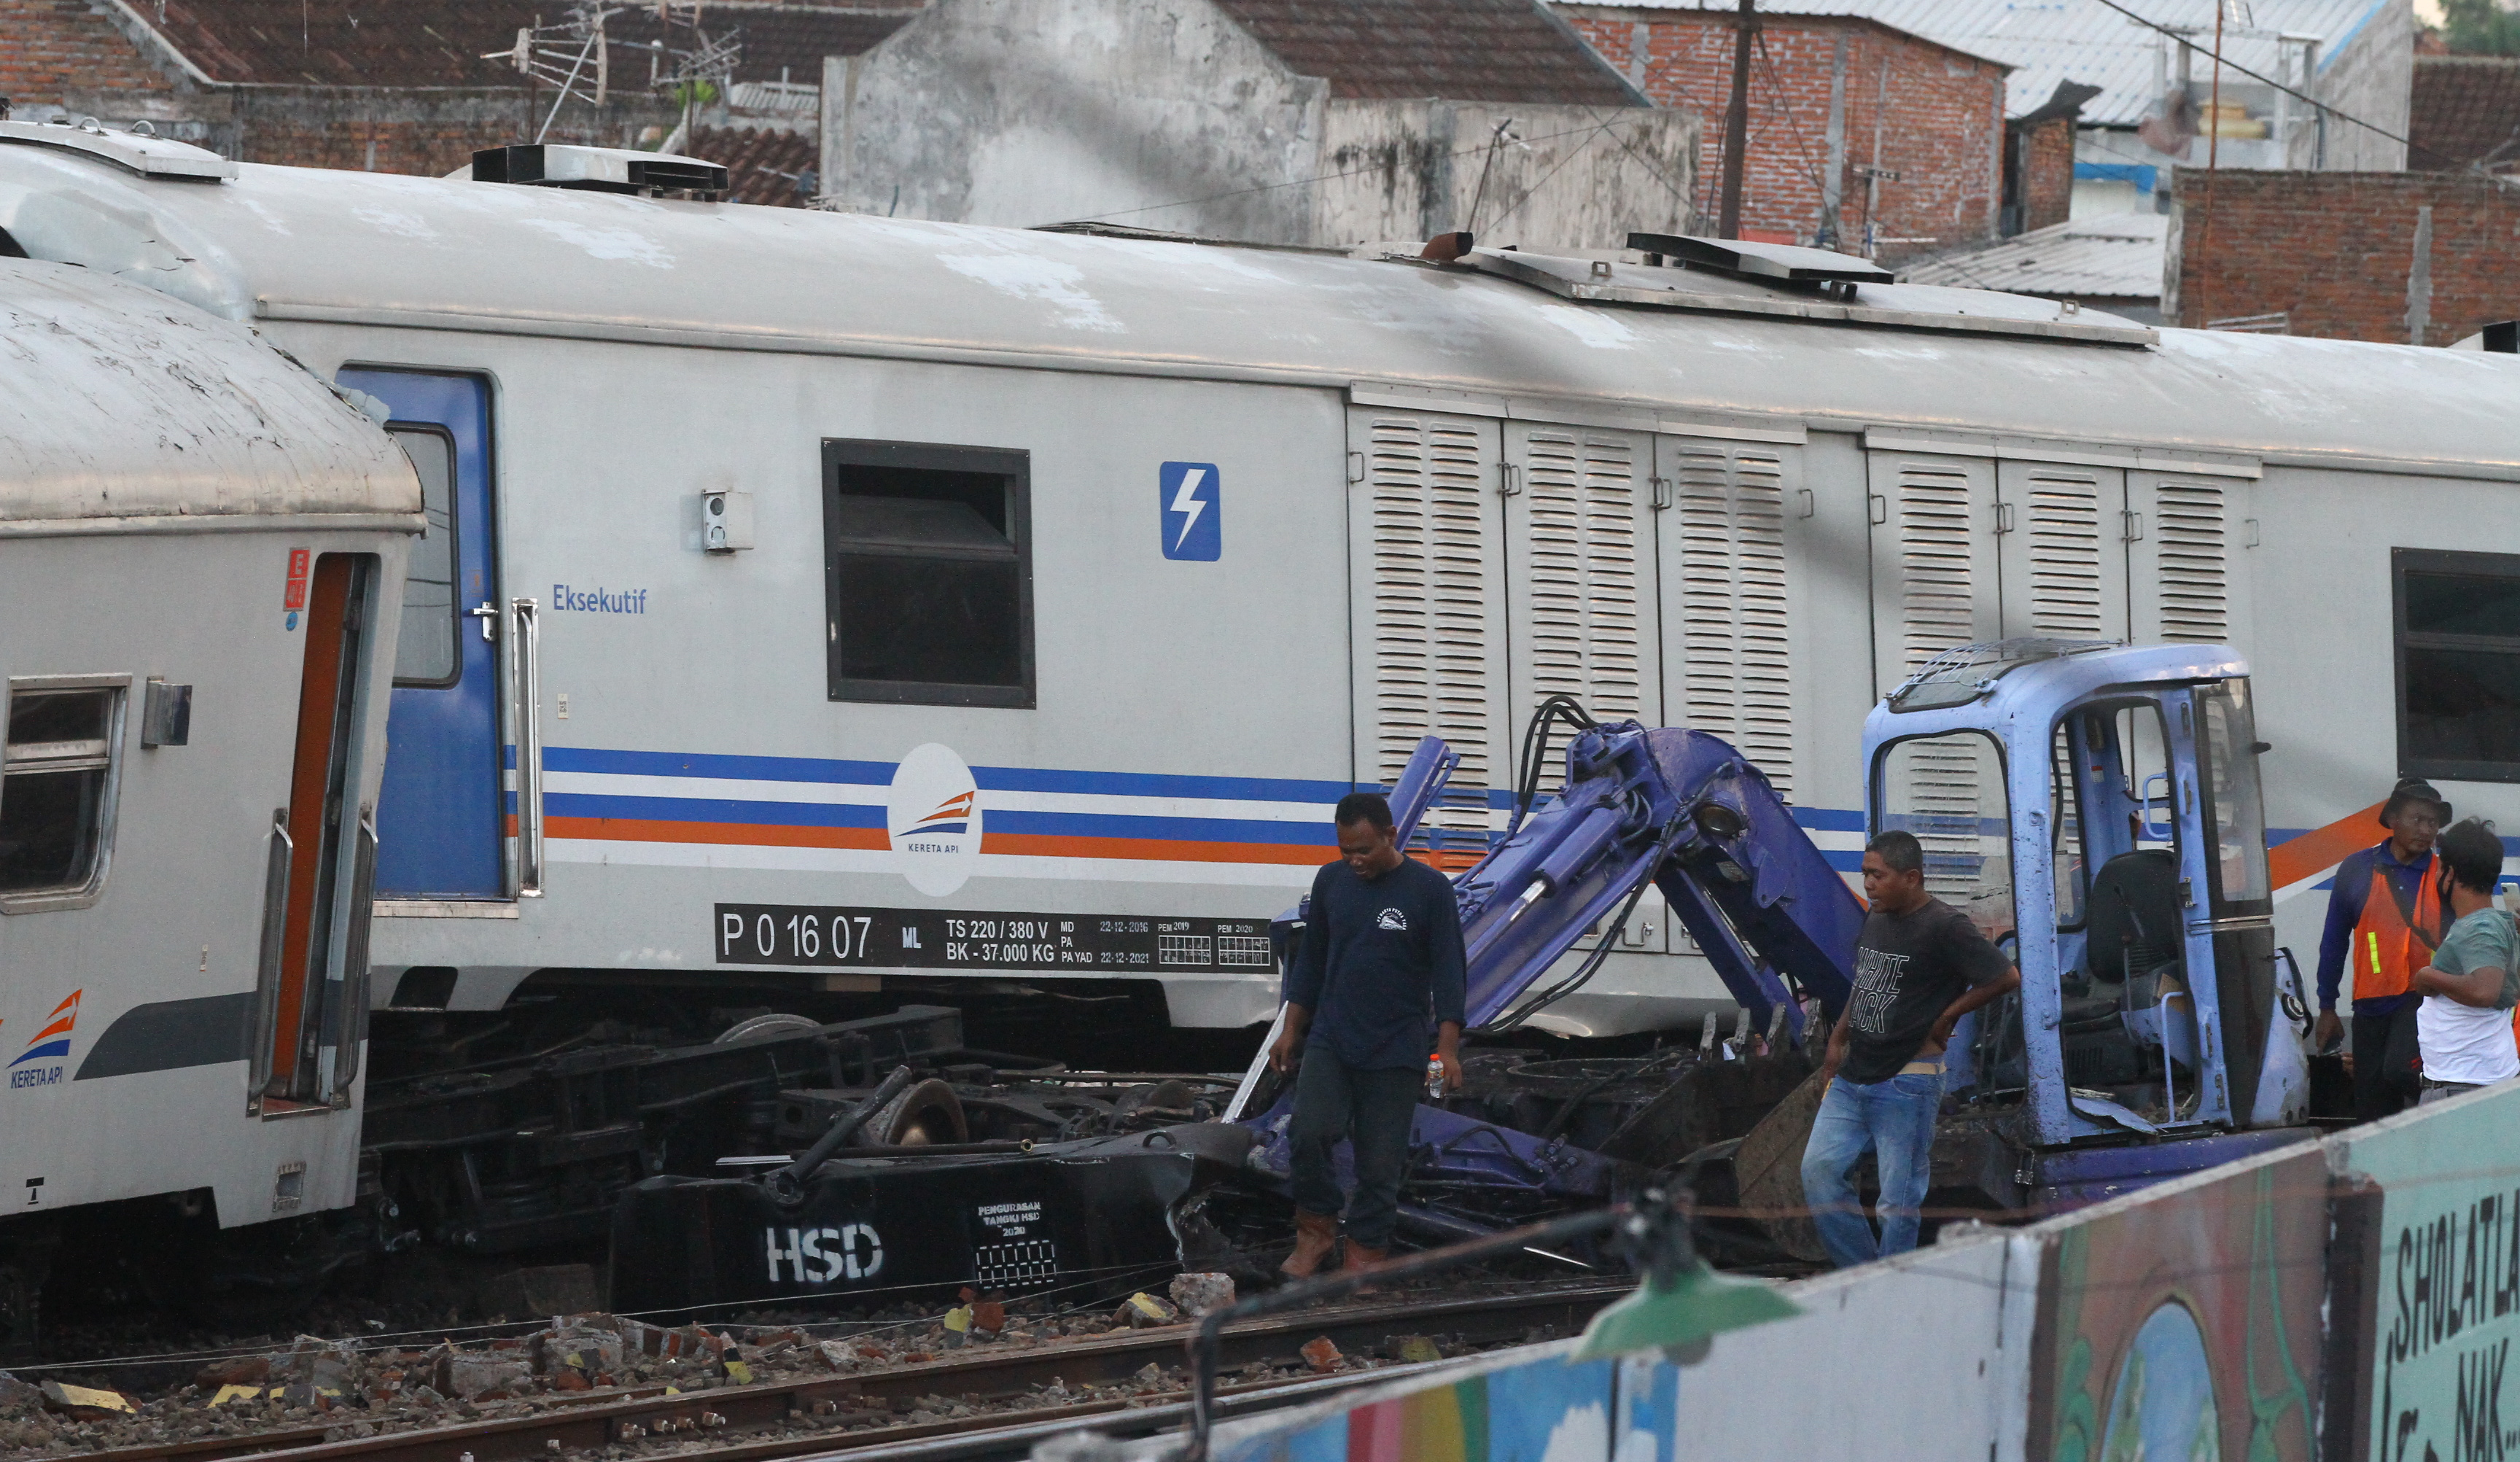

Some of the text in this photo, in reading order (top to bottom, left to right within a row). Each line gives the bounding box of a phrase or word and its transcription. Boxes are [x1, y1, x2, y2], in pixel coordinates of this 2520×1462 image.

[295, 553, 304, 575] E
[553, 584, 648, 614] Eksekutif
[908, 844, 959, 854] KERETA API
[723, 913, 744, 956] P
[946, 919, 966, 938] TS
[970, 920, 996, 938] 220
[1008, 921, 1034, 939] 380
[1038, 921, 1049, 939] V
[1060, 921, 1075, 933] MD
[1158, 921, 1189, 932] PEM 2019
[1218, 925, 1253, 933] PEM 2020
[902, 927, 922, 949] ML
[1061, 936, 1073, 947] PA
[946, 941, 969, 960] BK
[982, 943, 1028, 962] 37.000
[1032, 944, 1054, 963] KG
[1061, 952, 1073, 963] PA
[1074, 952, 1093, 963] YAD
[1856, 946, 1910, 994] WHITE
[10, 1066, 63, 1089] KERETA API
[978, 1202, 1041, 1216] PENGURASAN
[983, 1212, 1040, 1225] TANGKI HSD
[1003, 1226, 1026, 1237] 2020
[766, 1224, 884, 1283] HSD
